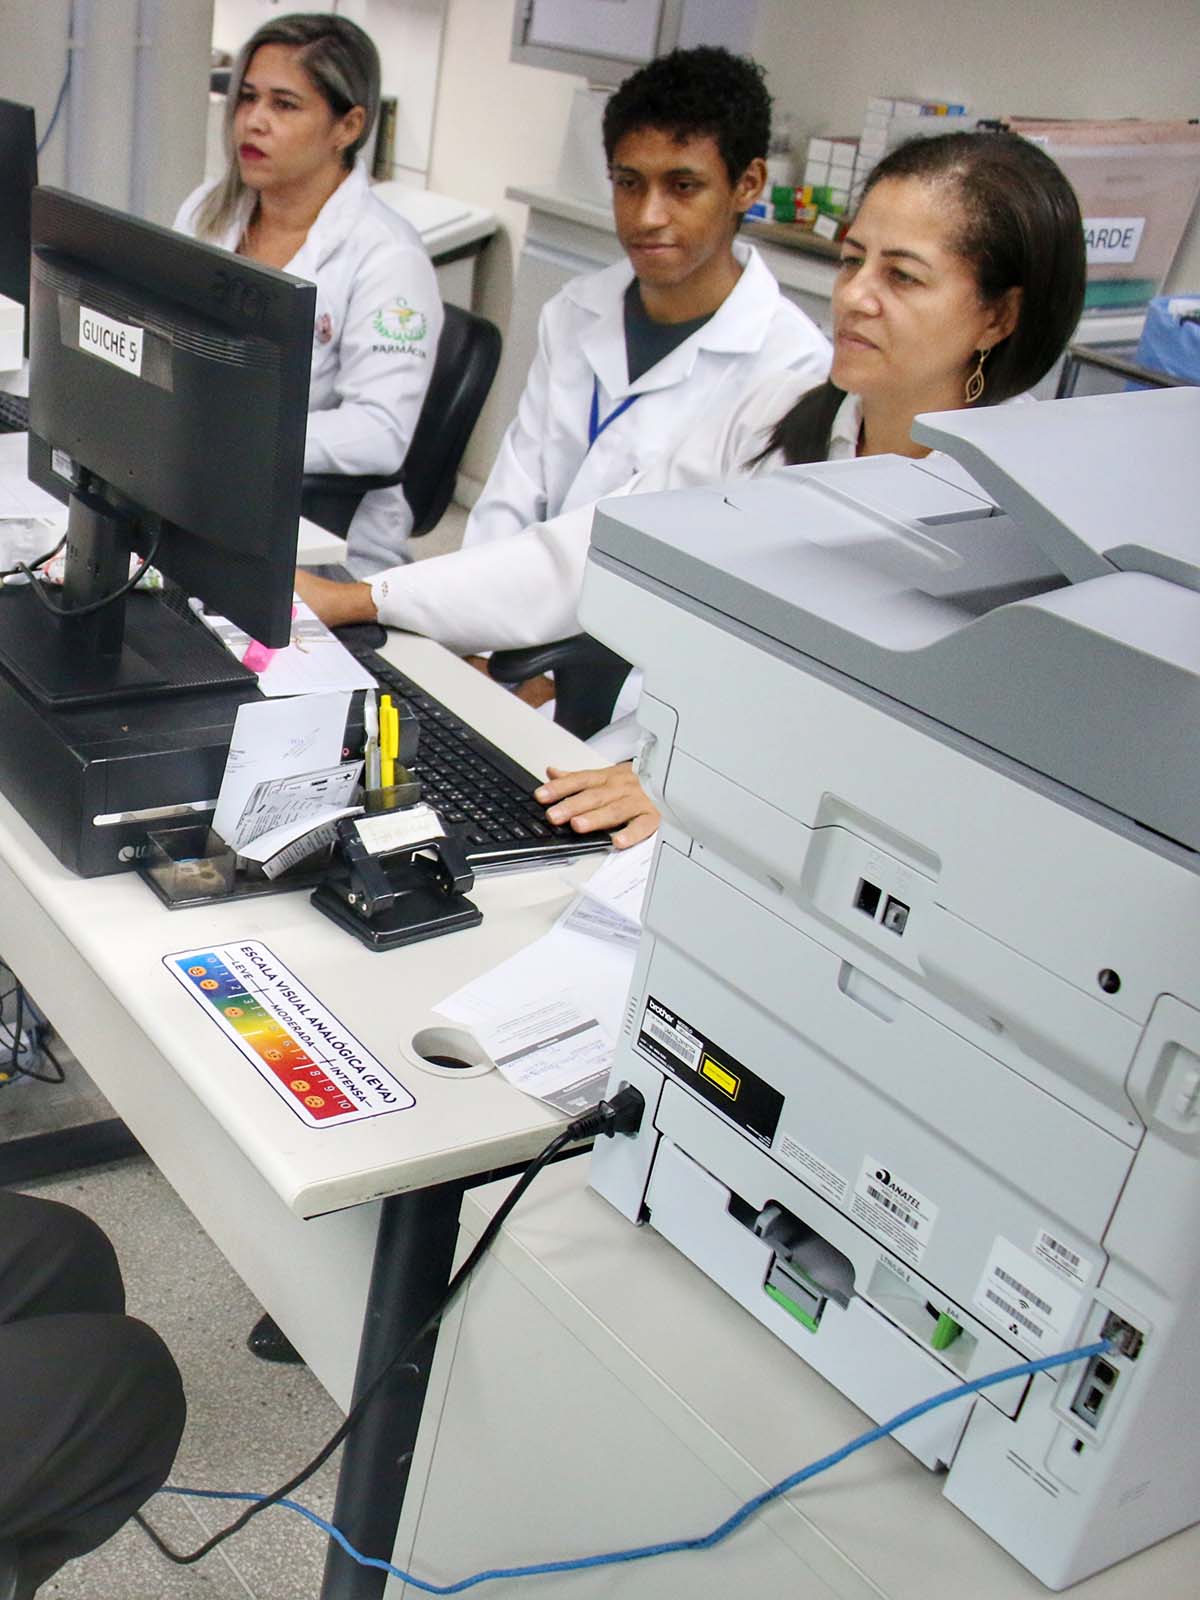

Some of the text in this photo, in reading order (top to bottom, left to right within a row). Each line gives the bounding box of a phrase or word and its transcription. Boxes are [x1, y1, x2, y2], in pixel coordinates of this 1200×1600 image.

[1084, 227, 1135, 249] ARDE
[83, 320, 137, 362] GUICHÊ 5
[232, 961, 254, 980] LEVE
[649, 1000, 674, 1023] brother
[241, 946, 397, 1104] ESCALA VISUAL ANALÓGICA (EVA)
[271, 1004, 314, 1047] MODERADA
[330, 1067, 366, 1102] INTENSA
[338, 1100, 351, 1109] 10
[889, 1183, 920, 1209] ANATEL
